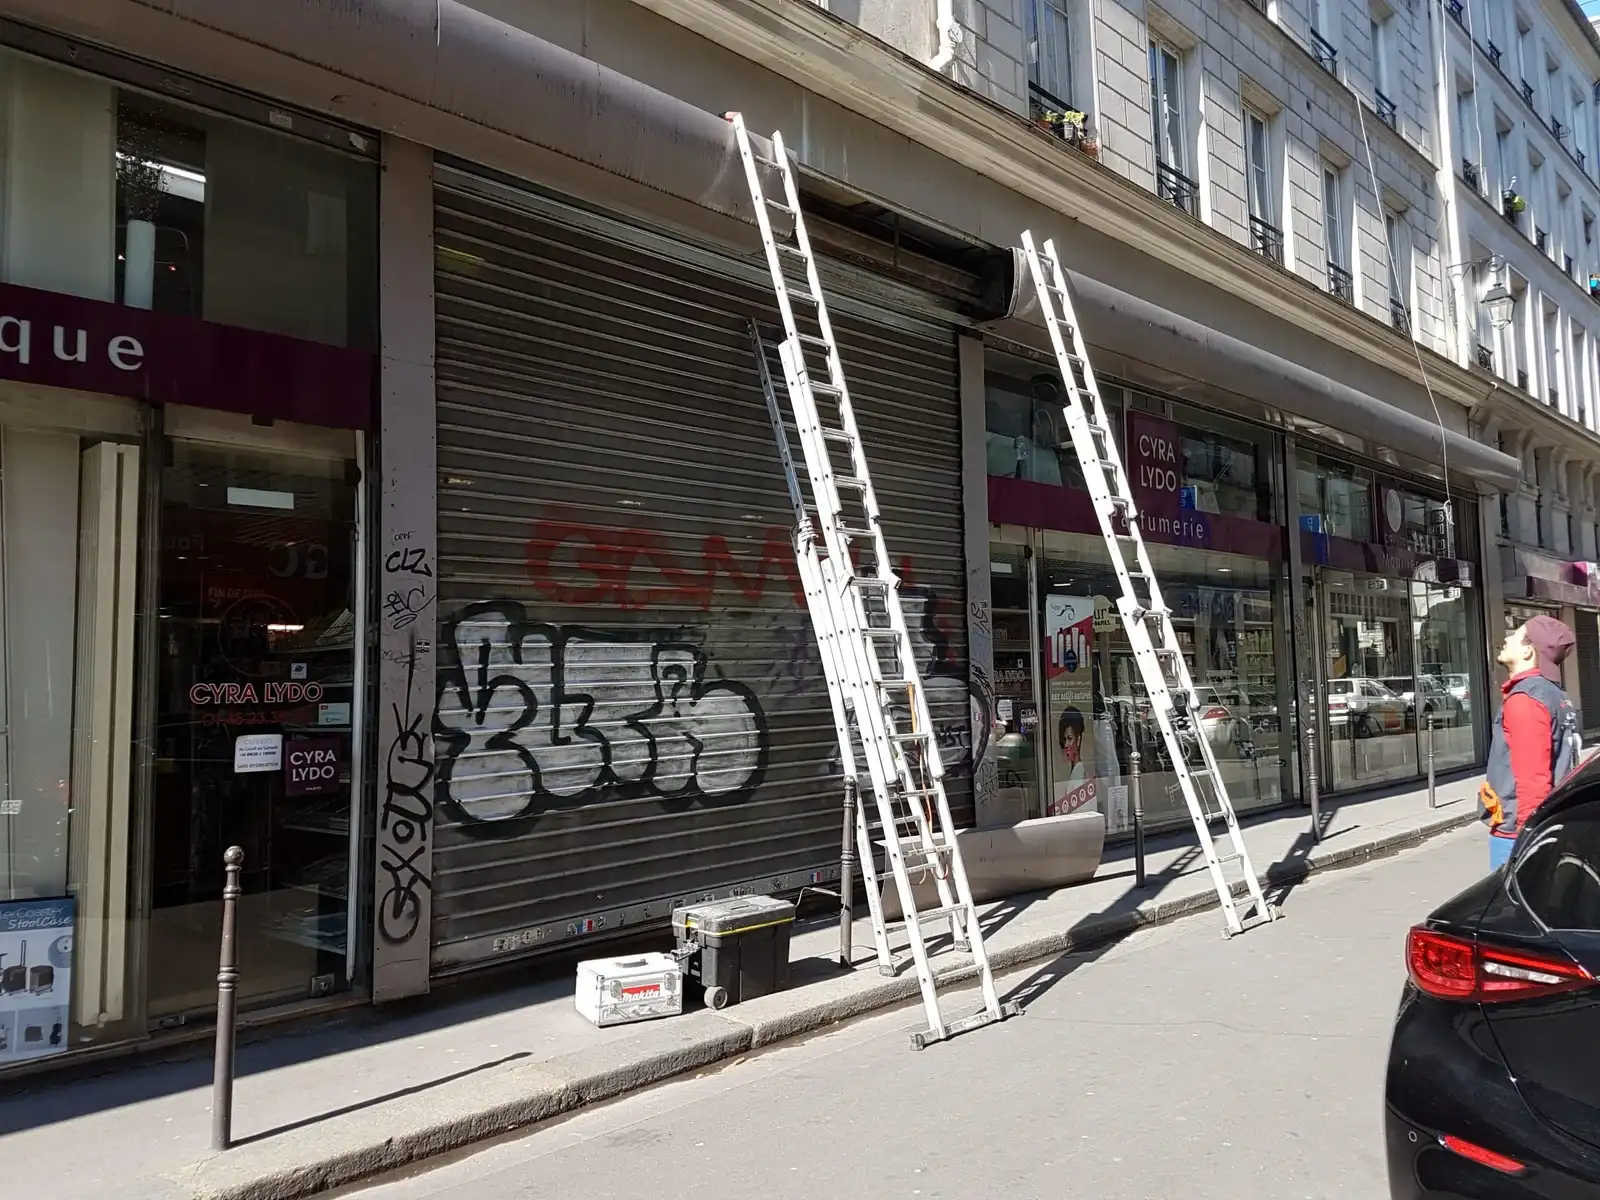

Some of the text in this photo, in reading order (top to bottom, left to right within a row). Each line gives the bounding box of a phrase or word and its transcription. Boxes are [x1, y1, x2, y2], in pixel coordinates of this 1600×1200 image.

[0, 315, 144, 371] que
[1139, 434, 1176, 463] CYRA
[1141, 465, 1177, 492] LYDO
[1110, 508, 1204, 539] Pafumerie
[189, 681, 324, 704] CYRA LYDO
[290, 749, 336, 765] CYRA
[292, 765, 335, 782] LYDO
